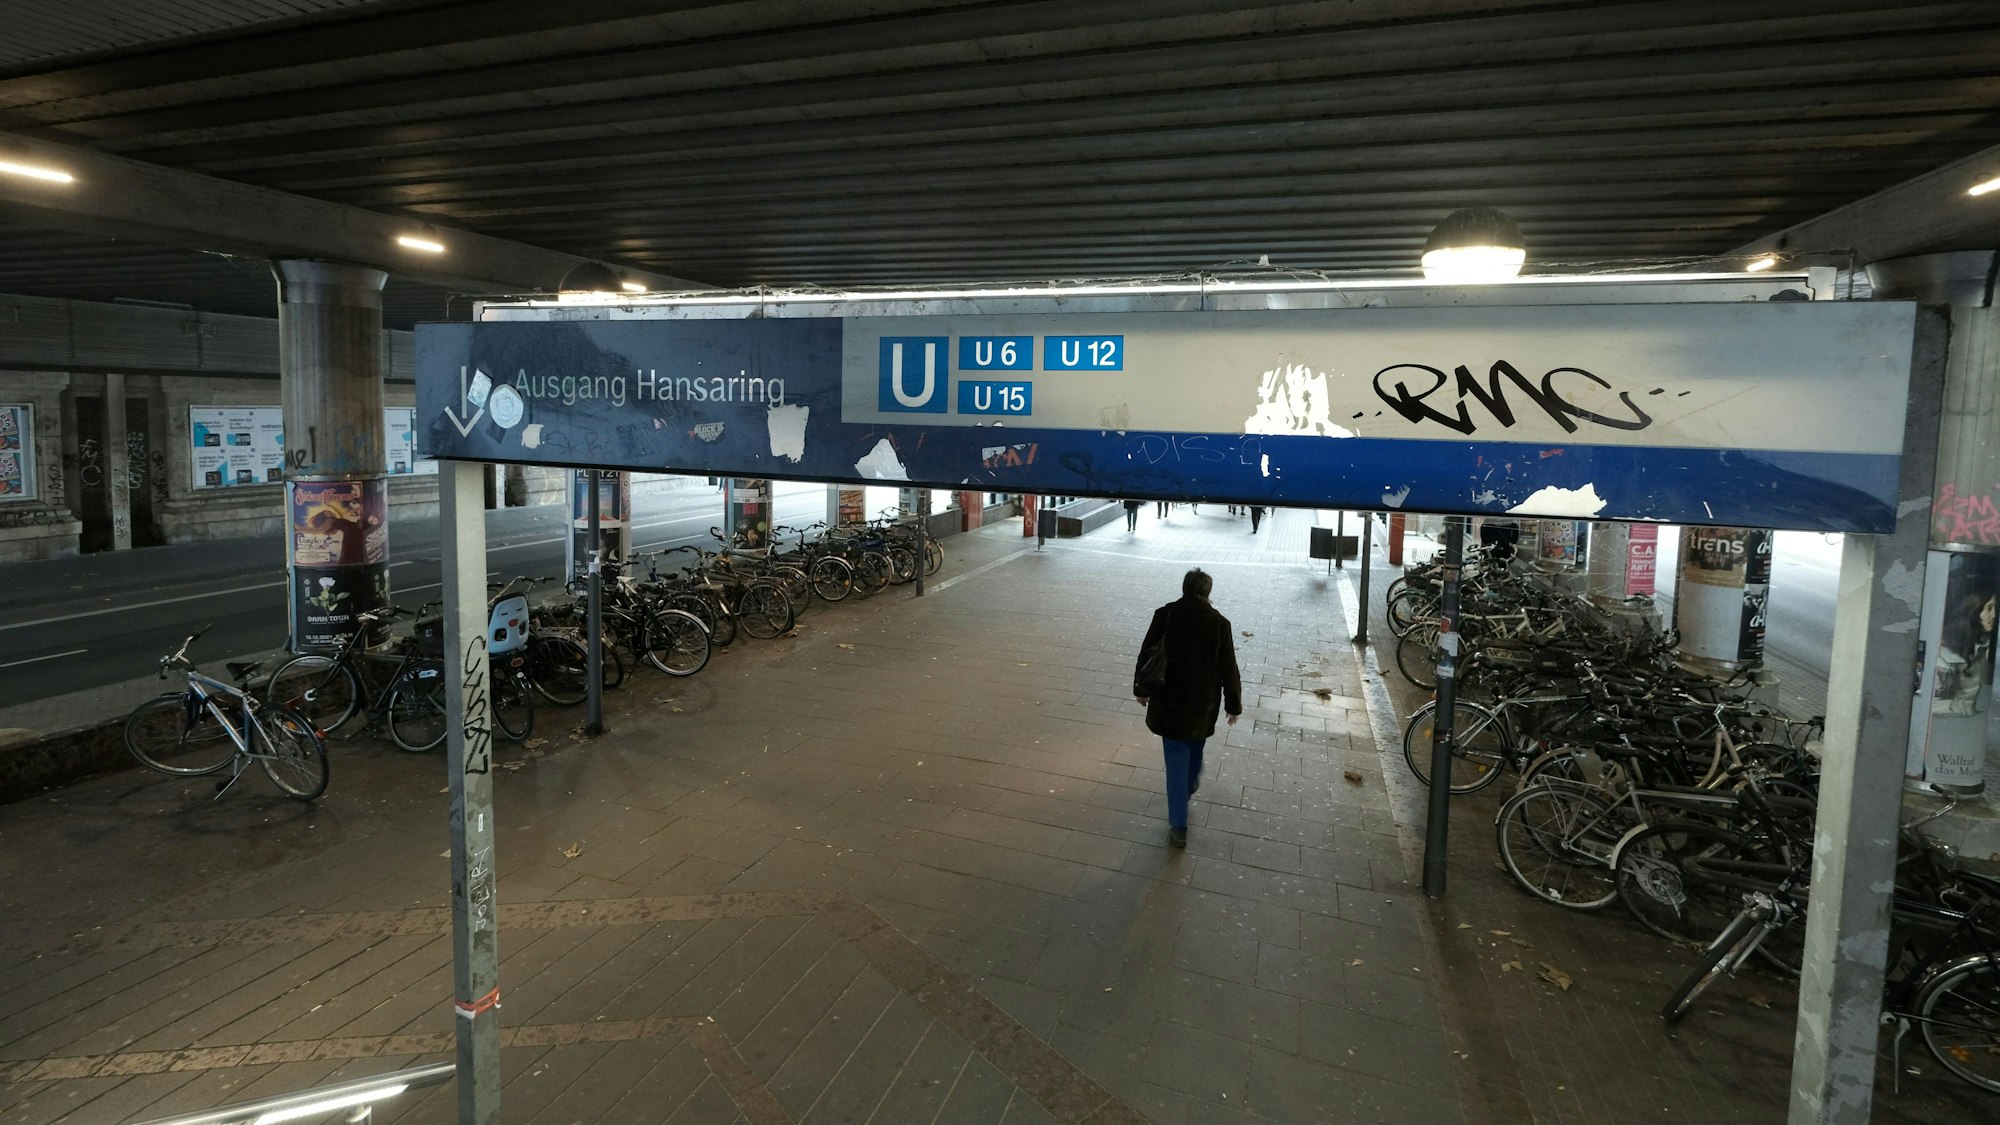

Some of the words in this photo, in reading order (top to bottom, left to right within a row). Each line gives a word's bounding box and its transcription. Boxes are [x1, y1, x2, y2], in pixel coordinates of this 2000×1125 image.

[975, 341, 993, 366] U
[1001, 341, 1017, 366] 6
[1061, 341, 1080, 366] U
[1087, 341, 1116, 366] 12
[515, 368, 627, 406] Ausgang
[637, 368, 786, 407] Hansaring
[891, 343, 935, 408] U
[974, 386, 992, 410] U
[999, 386, 1025, 411] 15
[576, 469, 619, 478] PLY21
[1690, 533, 1745, 555] trans
[1935, 764, 1955, 775] das
